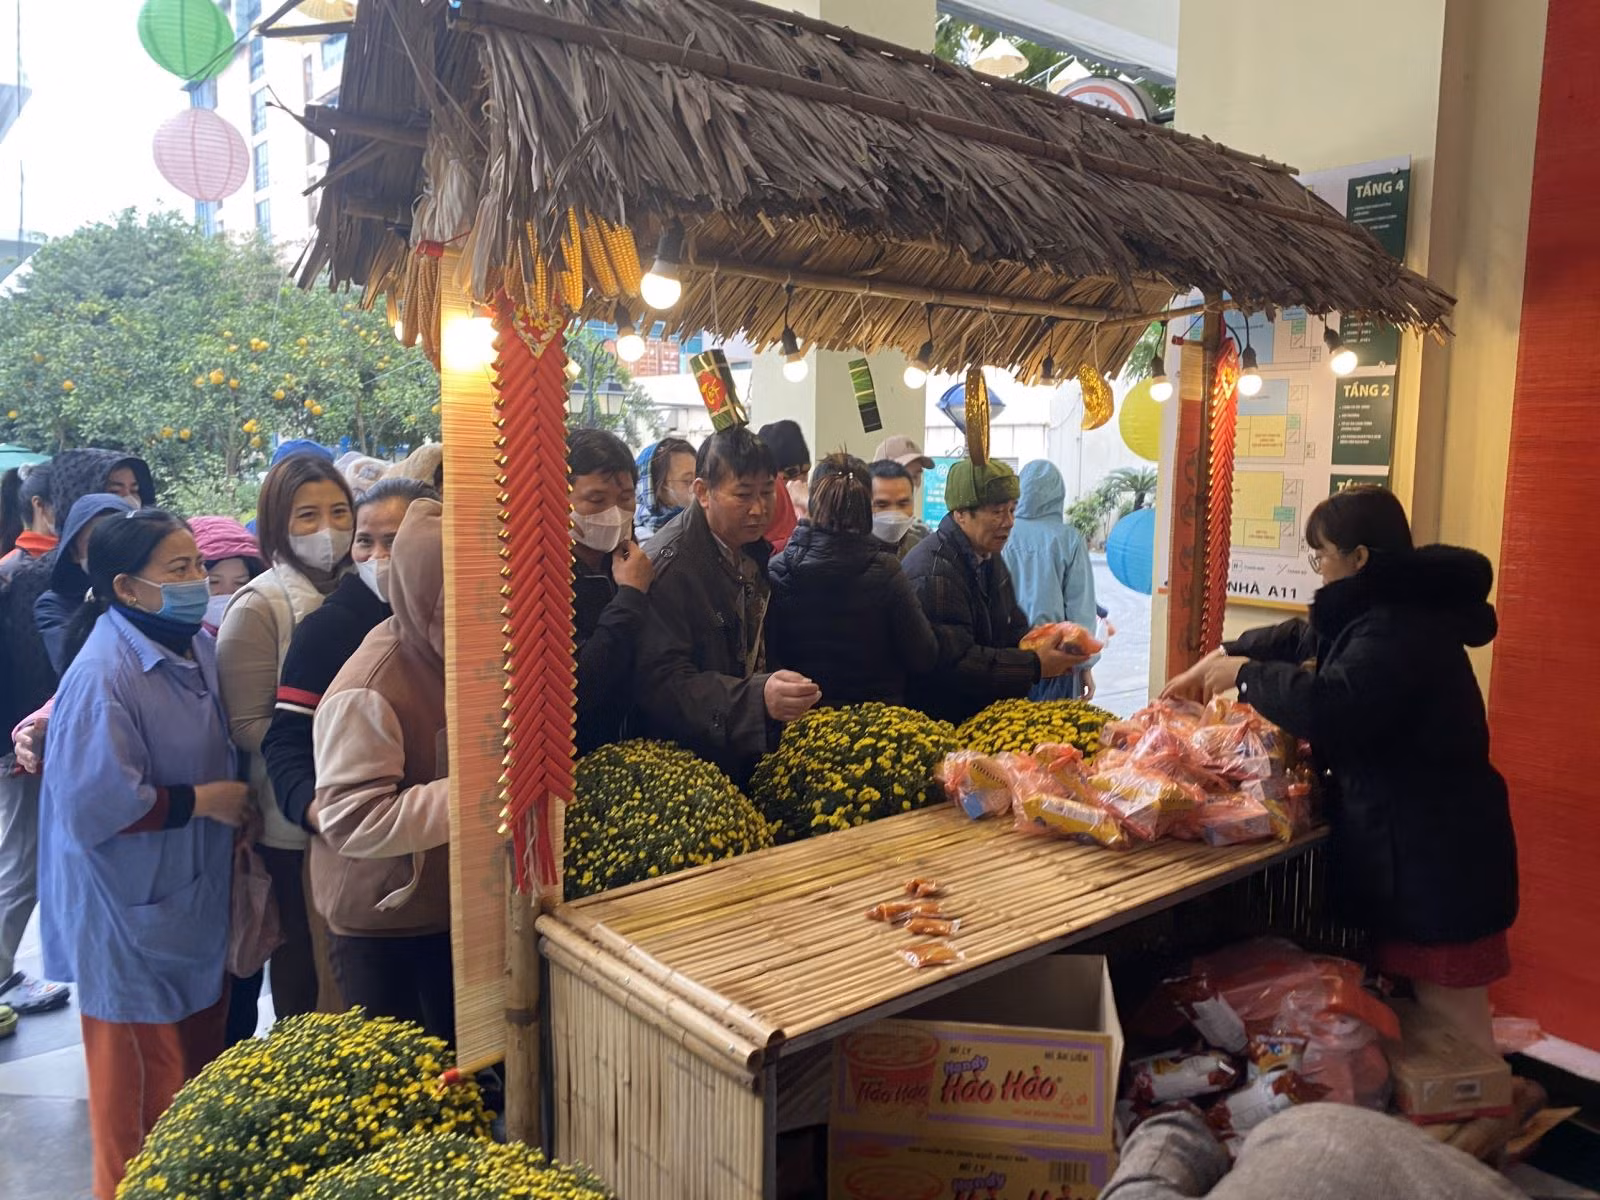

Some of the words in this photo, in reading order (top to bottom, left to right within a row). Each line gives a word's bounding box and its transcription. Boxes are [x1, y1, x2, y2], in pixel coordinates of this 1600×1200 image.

[1395, 179, 1405, 193] 4
[1381, 383, 1390, 397] 2
[1268, 585, 1297, 599] A11
[940, 1067, 996, 1105] Hảo
[1001, 1065, 1058, 1102] Hảo
